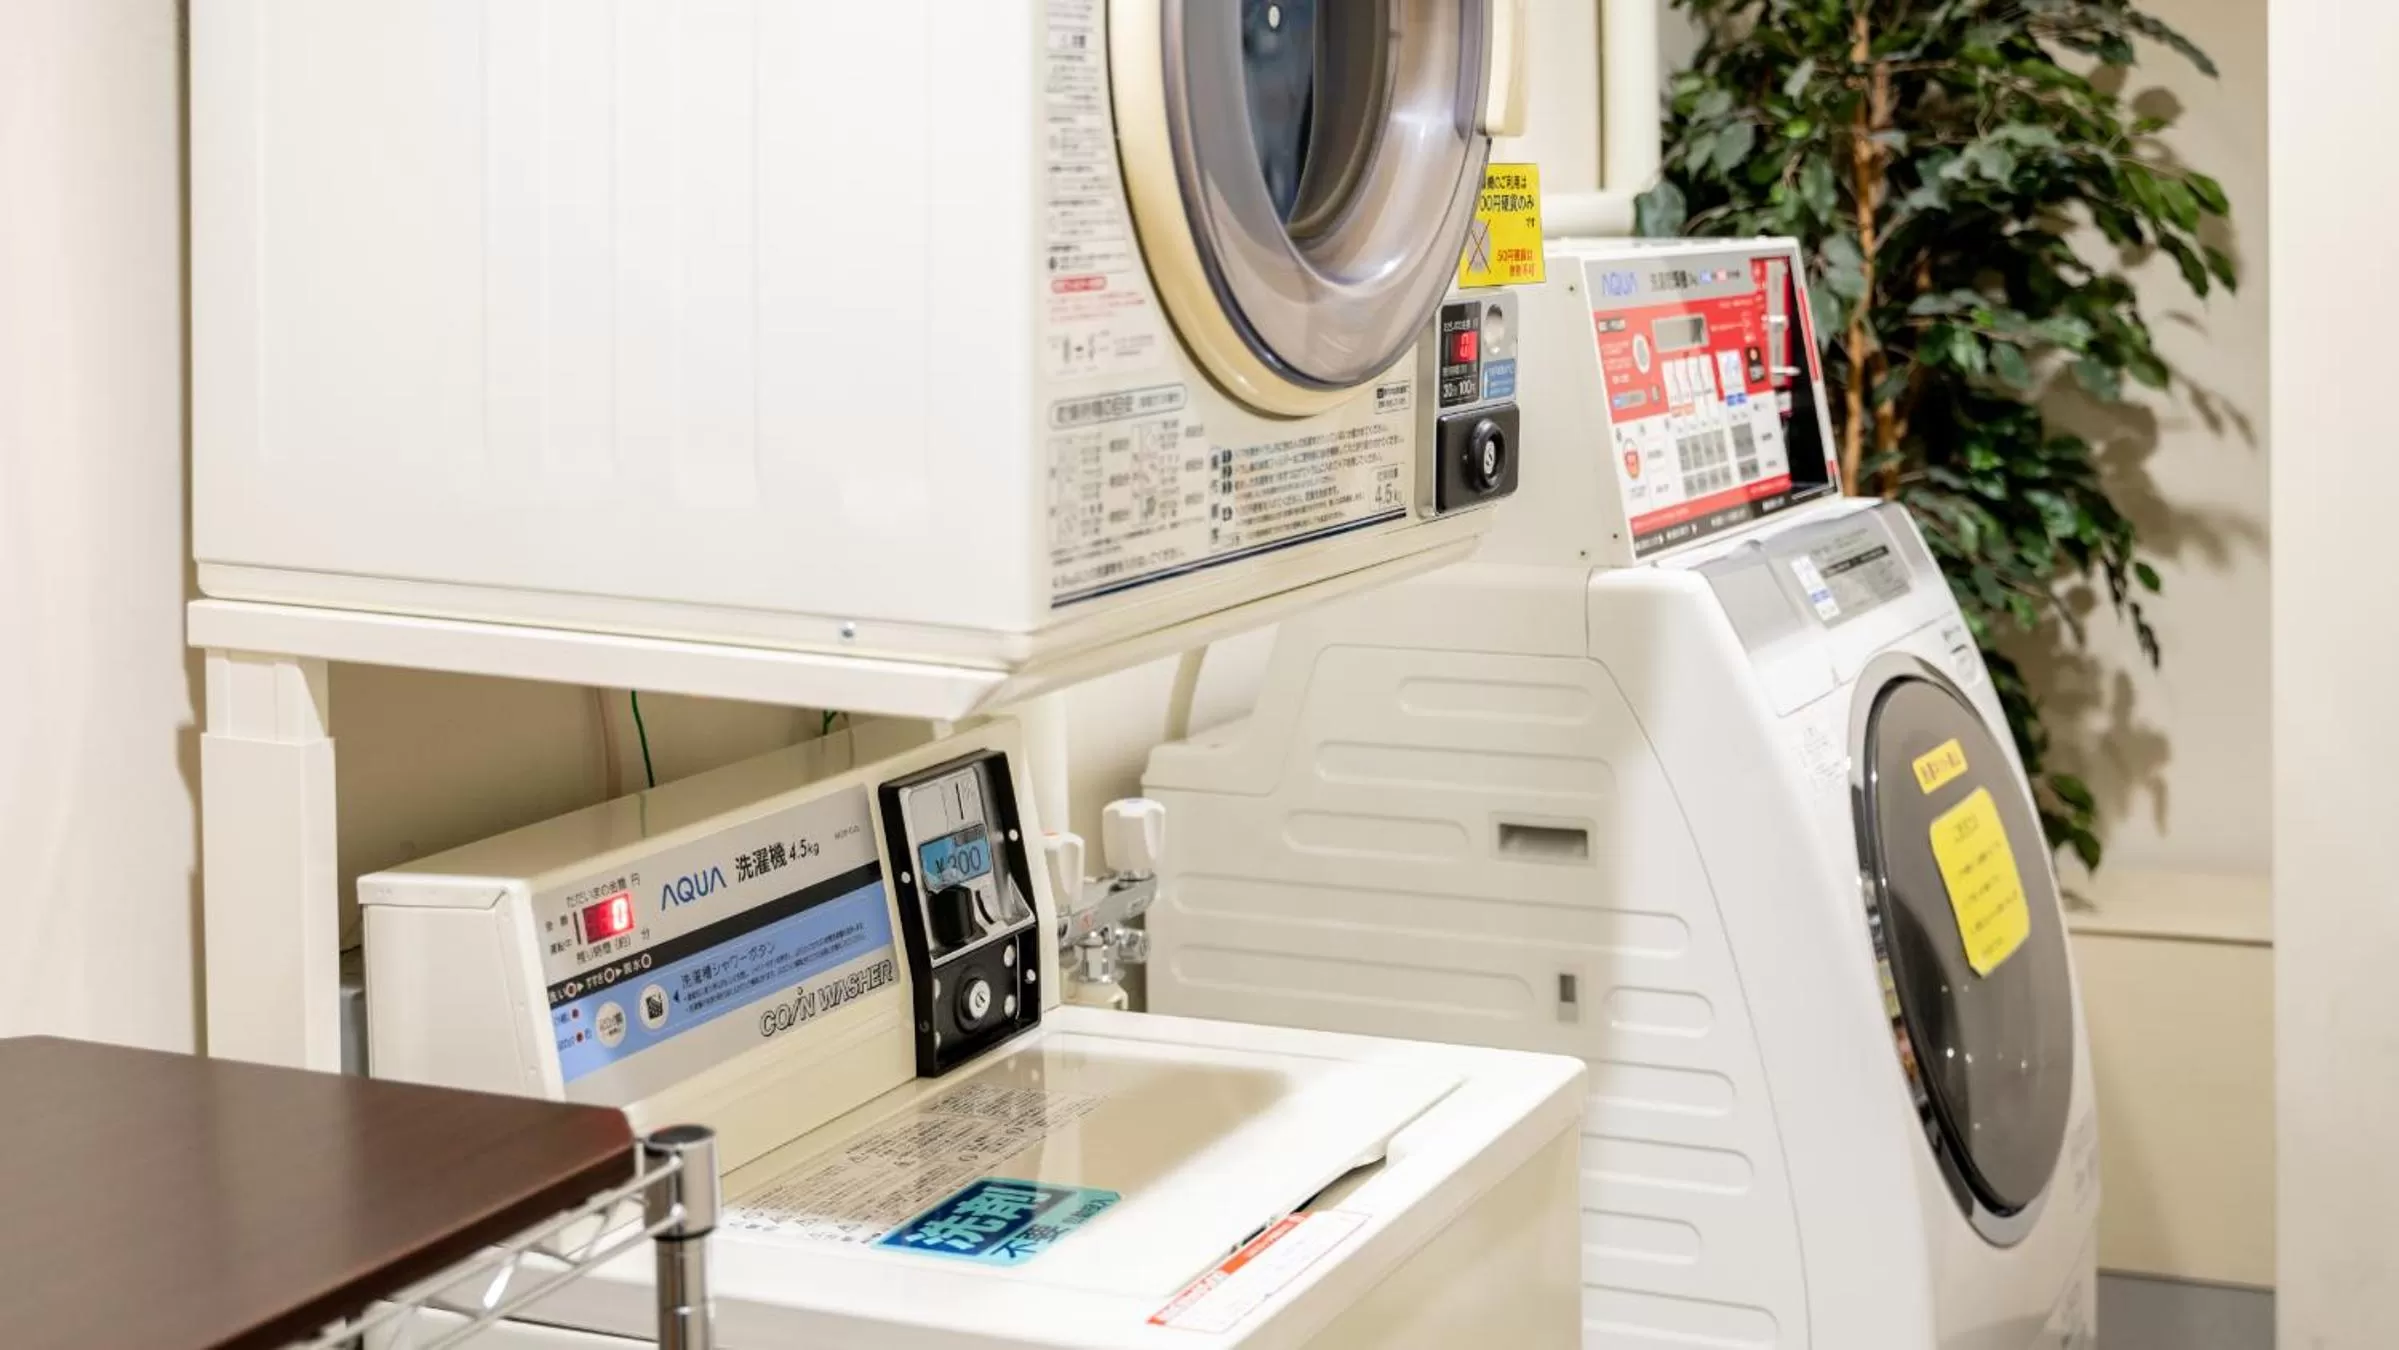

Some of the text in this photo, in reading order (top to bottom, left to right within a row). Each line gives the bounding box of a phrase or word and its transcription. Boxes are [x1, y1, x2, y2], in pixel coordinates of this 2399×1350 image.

[1481, 175, 1527, 190] 機のご利用は
[661, 838, 821, 912] AQUA 洗濯機 4.5kg
[611, 898, 629, 931] 0
[760, 986, 816, 1037] COIN
[816, 959, 893, 1011] WASHER
[905, 1186, 1053, 1250] 洗剤
